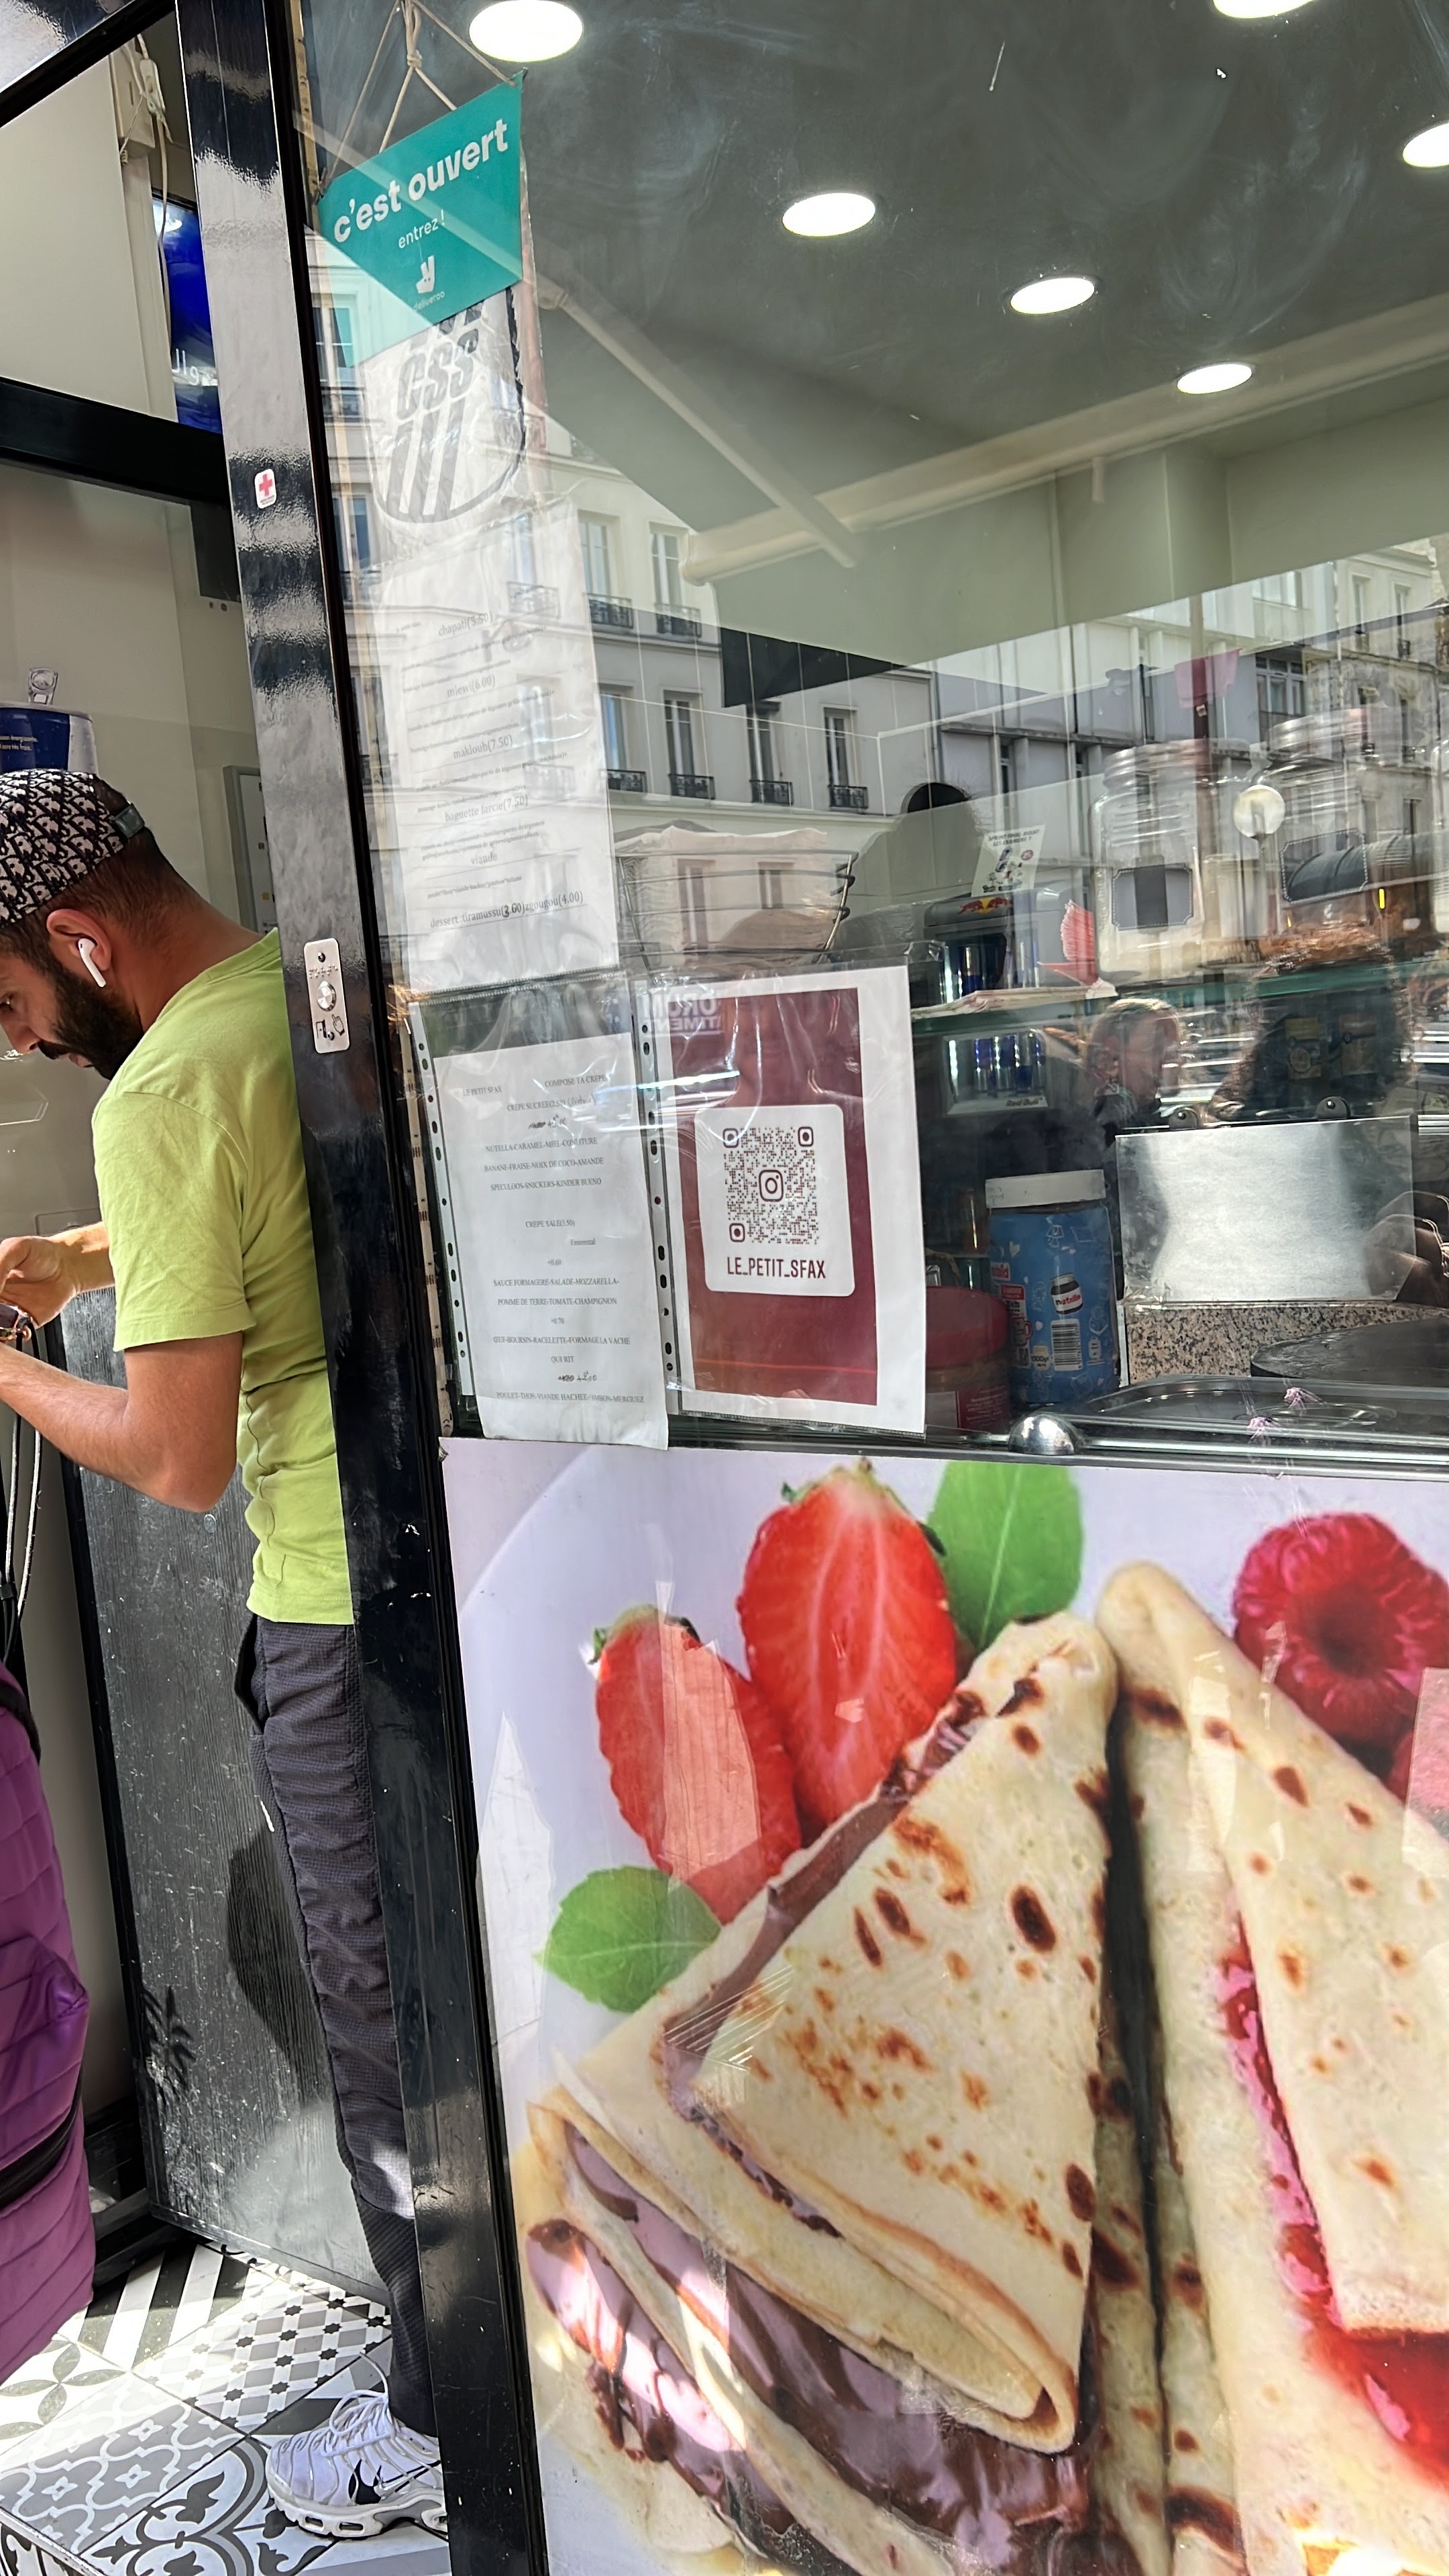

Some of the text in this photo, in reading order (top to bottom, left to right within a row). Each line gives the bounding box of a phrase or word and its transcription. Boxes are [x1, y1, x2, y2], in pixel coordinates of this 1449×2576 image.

[334, 119, 508, 243] c'est ouvert
[398, 218, 439, 248] entrez
[453, 735, 513, 759] makloub(7.50)
[445, 808, 480, 822] baguette
[471, 851, 498, 865] viande
[430, 916, 459, 928] dessert
[544, 1078, 576, 1087] COMPOSE
[506, 1103, 525, 1112] CREPE
[581, 1177, 602, 1186] BUENO
[525, 1220, 545, 1228] CREPE
[727, 1256, 826, 1279] LE_PETIT_SFAX
[493, 1279, 513, 1287] SAUCE
[529, 1297, 617, 1305] TERRE-TOMATE-CHAMPIGNON
[608, 1337, 630, 1345] VACHE
